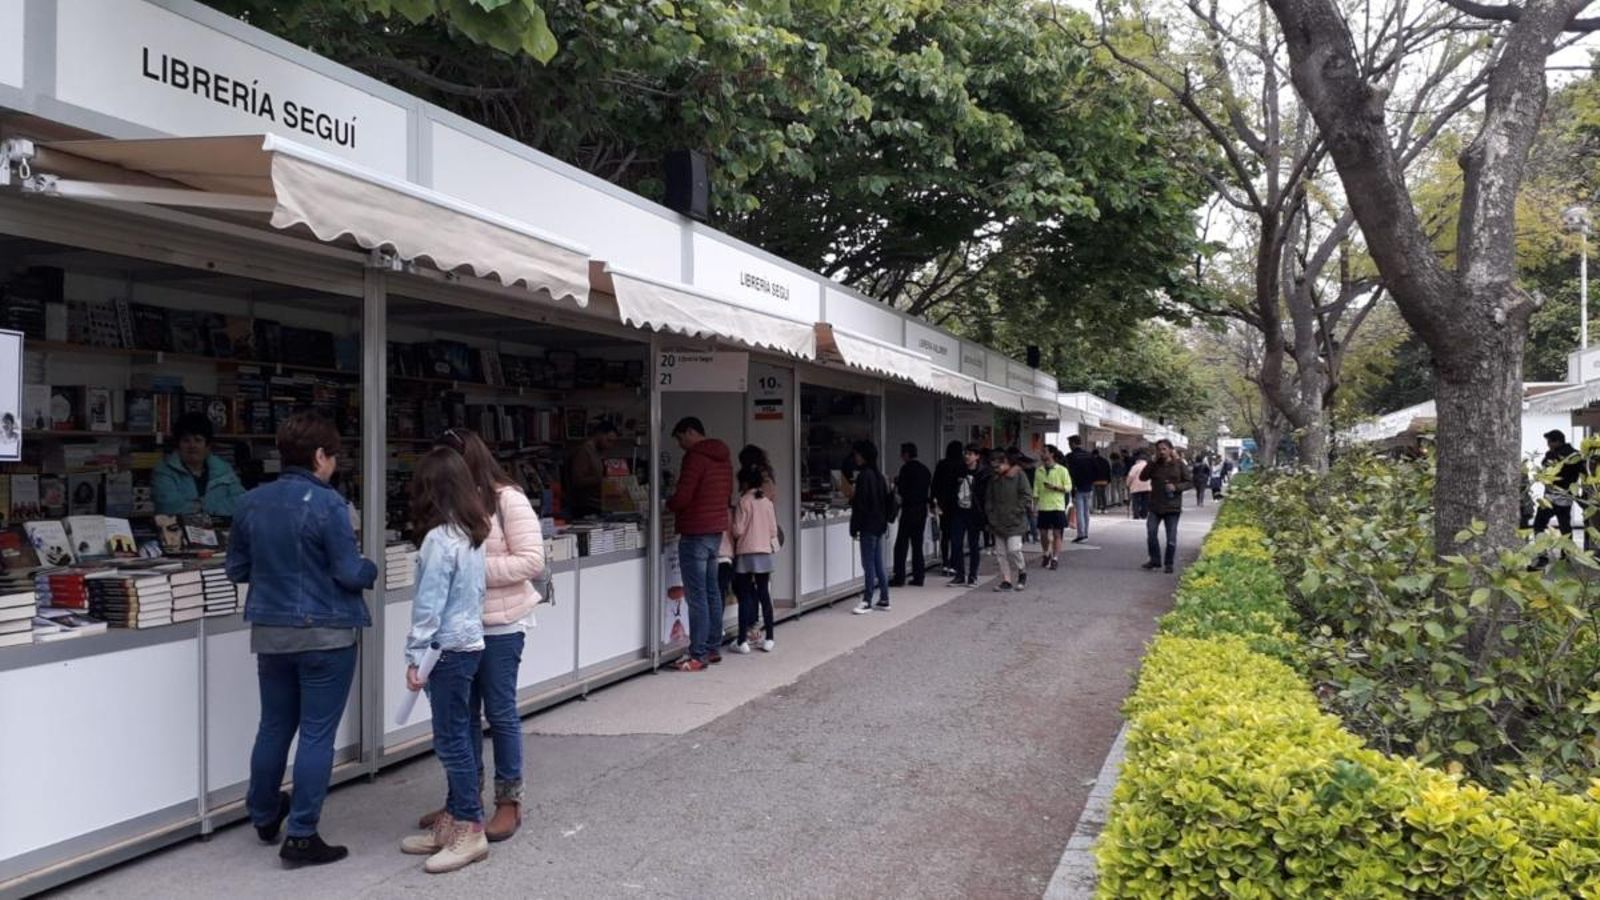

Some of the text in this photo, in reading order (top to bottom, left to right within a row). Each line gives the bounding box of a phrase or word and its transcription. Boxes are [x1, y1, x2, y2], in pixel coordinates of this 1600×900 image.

[142, 47, 358, 149] LIBRERÍA SEGUÍ
[661, 354, 675, 367] 20
[660, 373, 672, 385] 21
